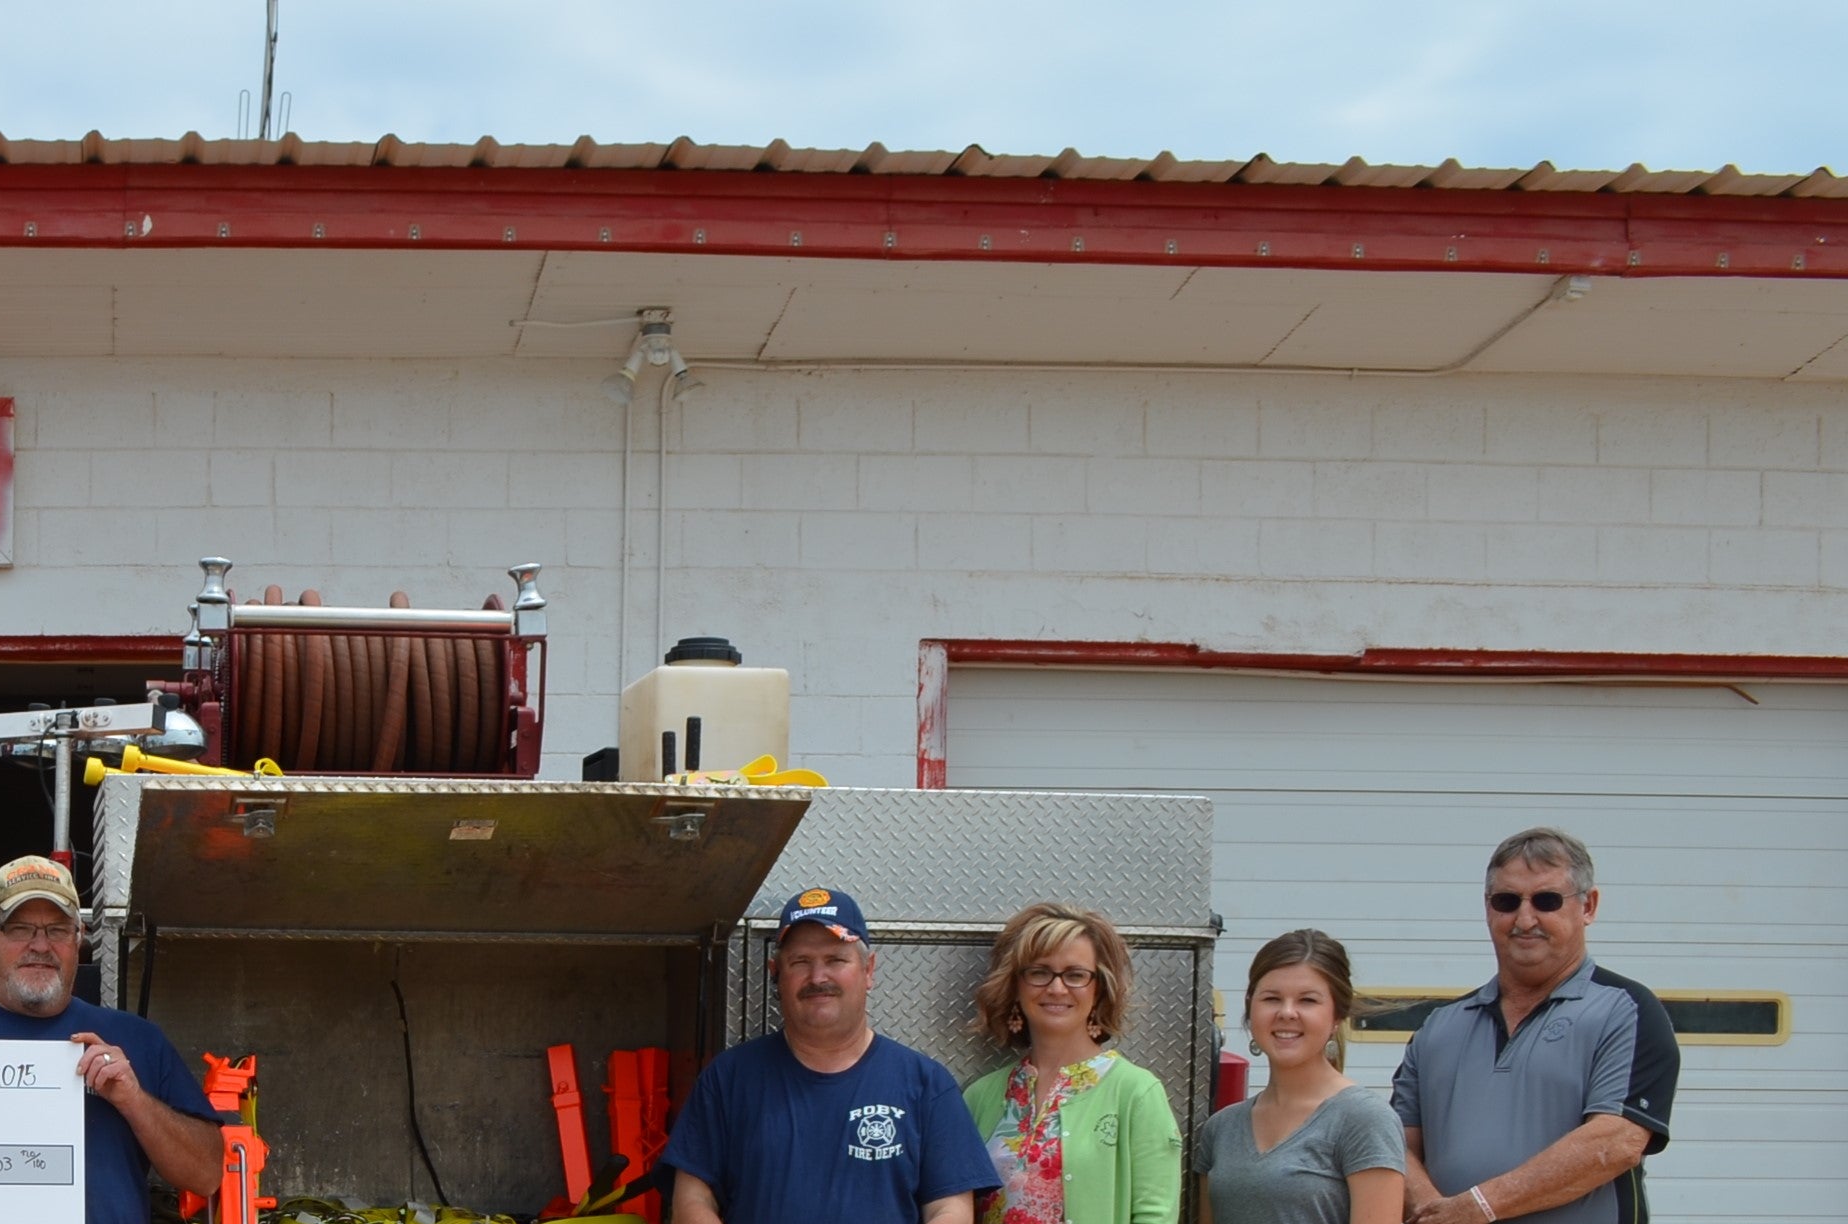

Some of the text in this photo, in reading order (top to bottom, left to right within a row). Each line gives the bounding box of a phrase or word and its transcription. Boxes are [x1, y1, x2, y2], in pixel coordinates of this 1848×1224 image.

[849, 1104, 905, 1121] ROBY
[848, 1143, 904, 1161] FIRE DEPT.
